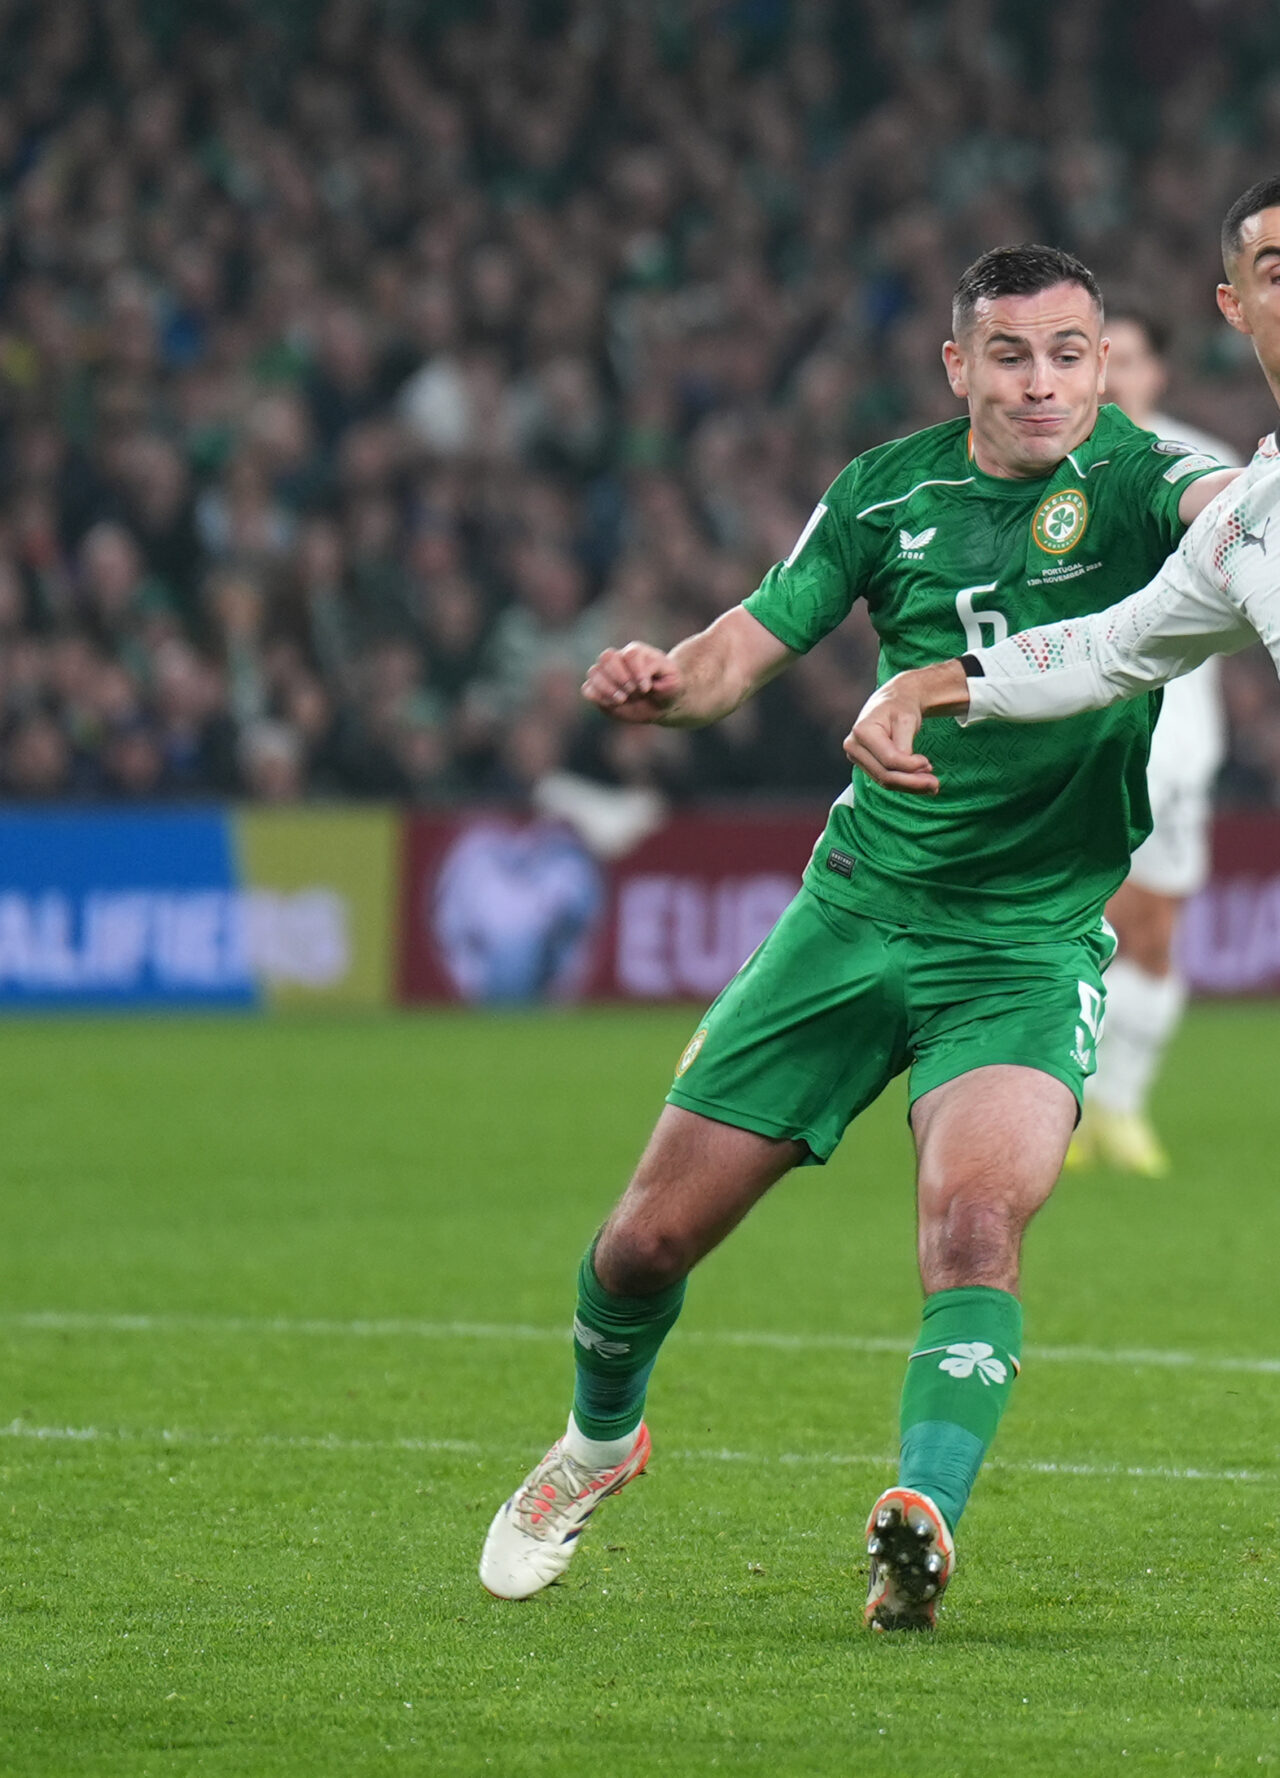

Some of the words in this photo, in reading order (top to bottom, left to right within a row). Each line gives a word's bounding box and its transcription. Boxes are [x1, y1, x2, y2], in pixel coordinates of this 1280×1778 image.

[1039, 494, 1084, 518] IRELAND
[1042, 562, 1083, 576] PORTUGAL
[1043, 567, 1086, 584] NOVEMBER
[955, 580, 1008, 651] 6
